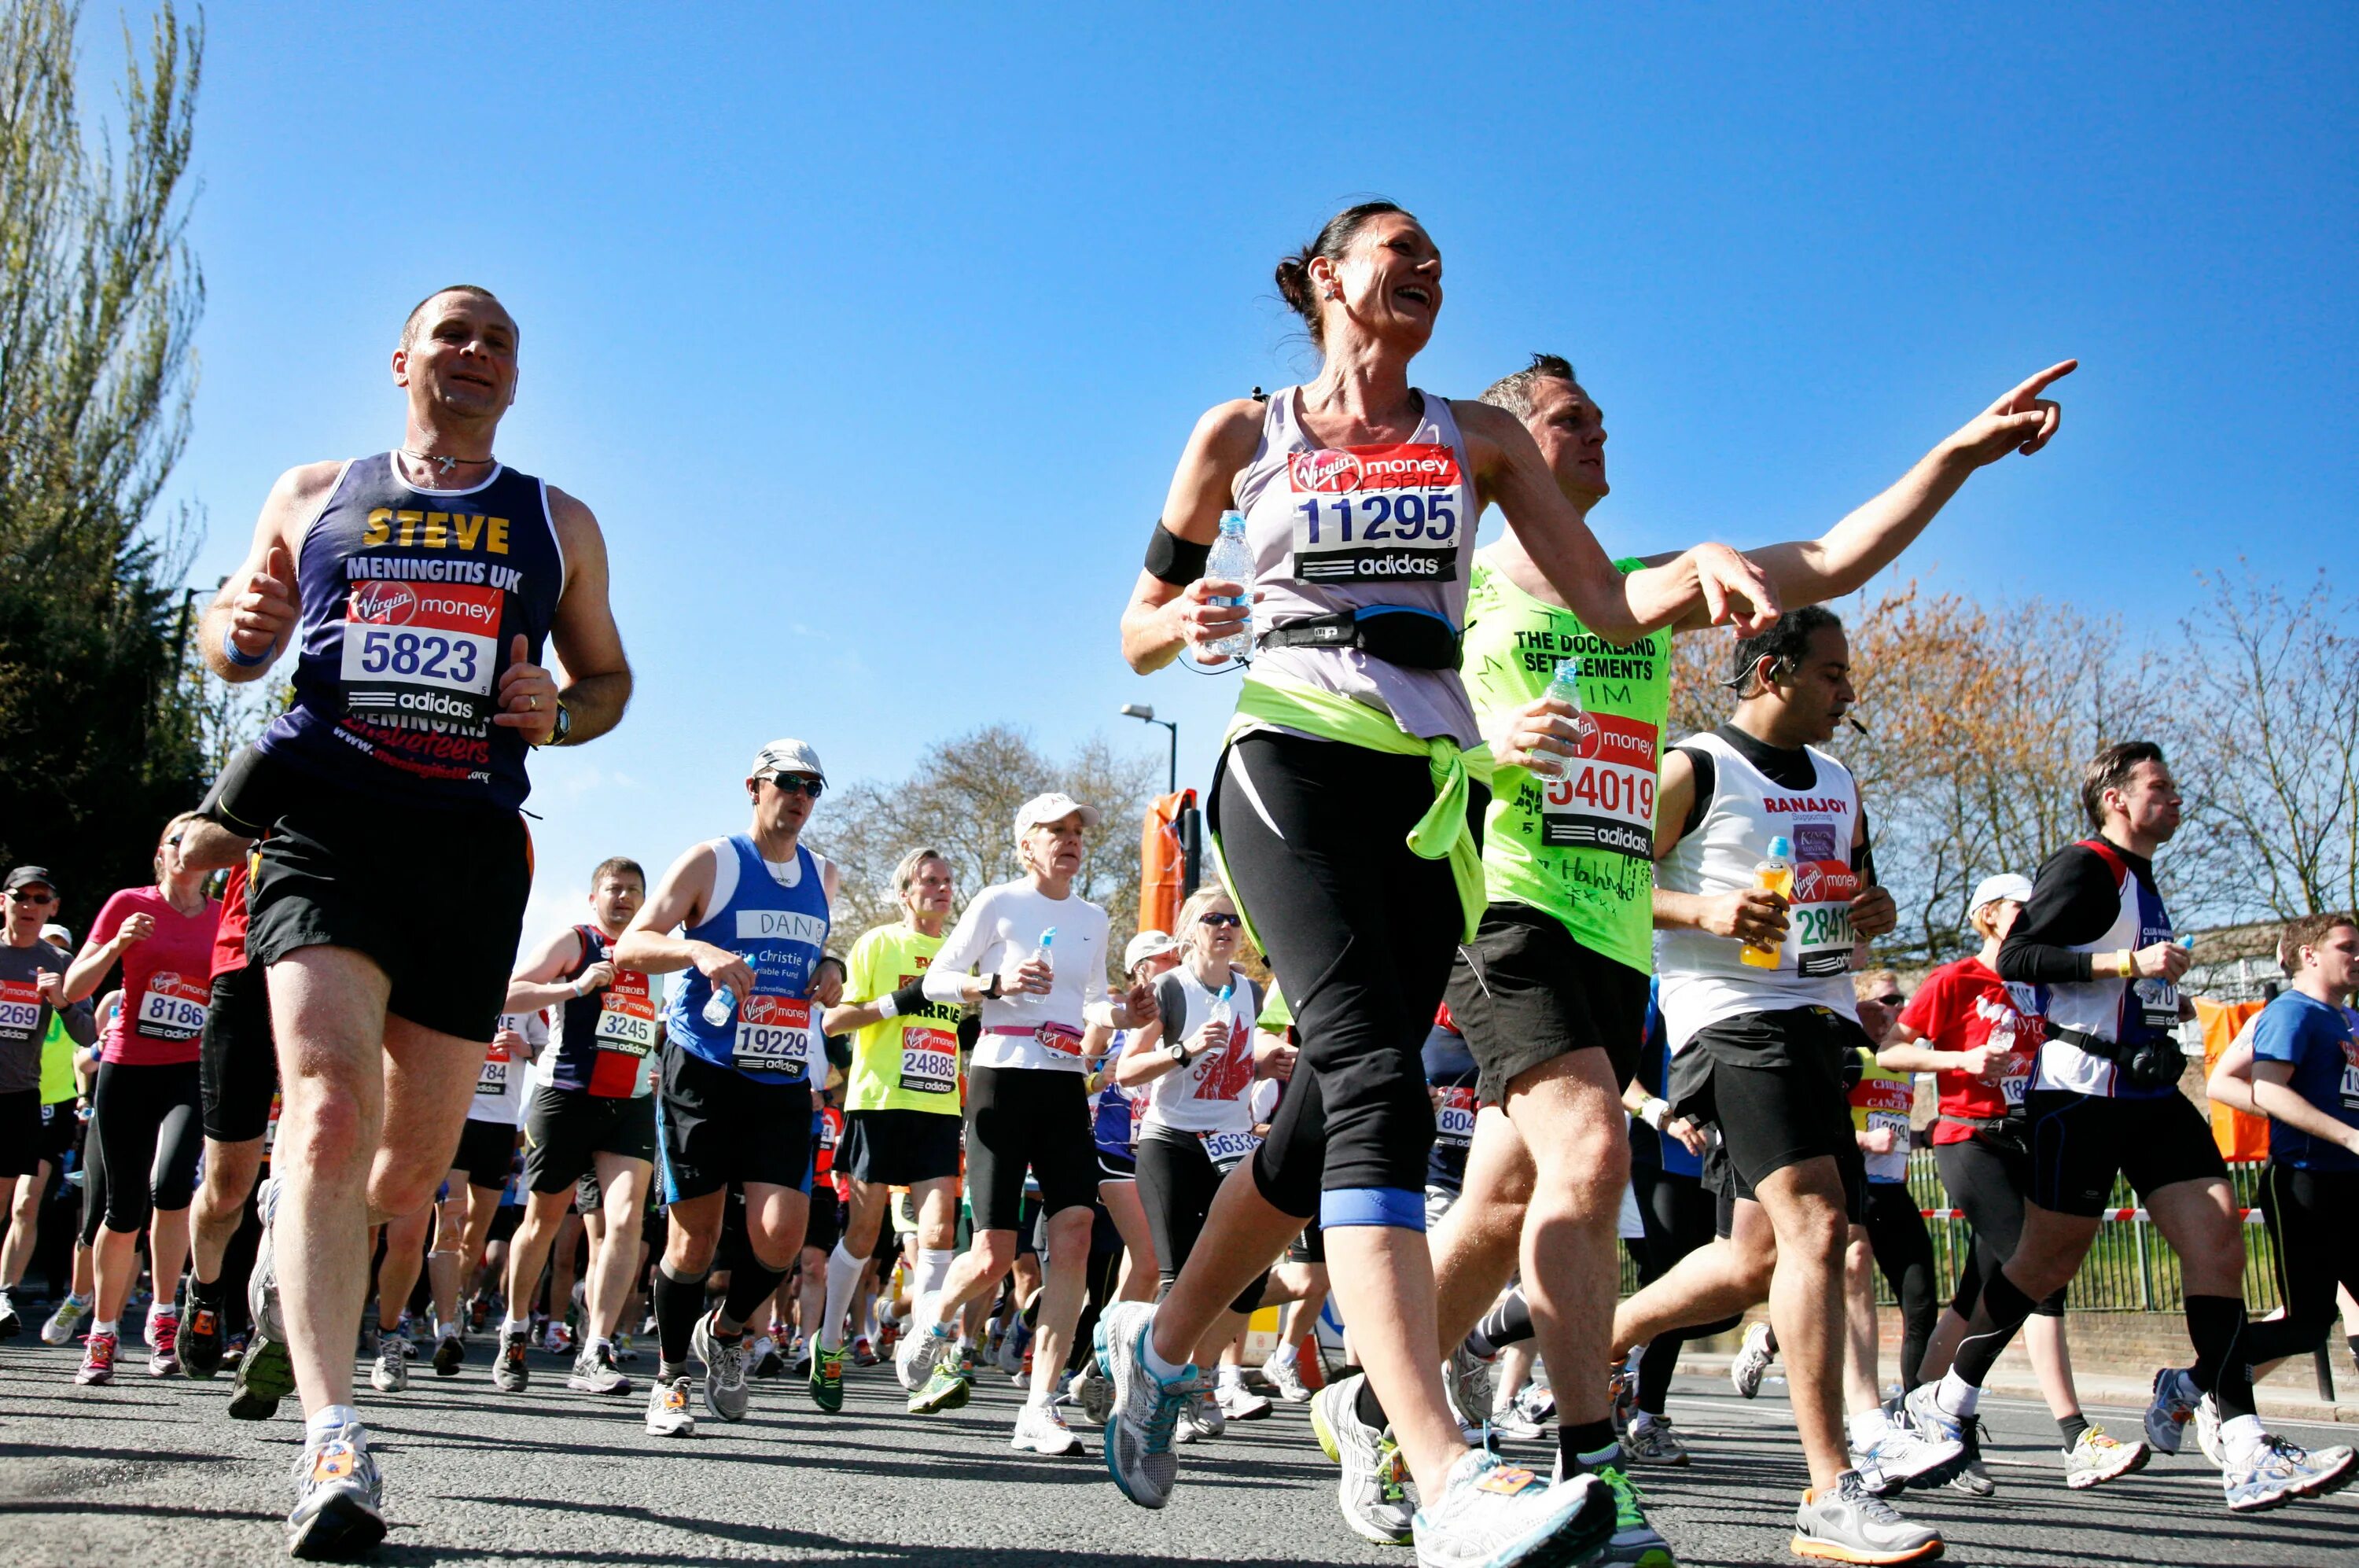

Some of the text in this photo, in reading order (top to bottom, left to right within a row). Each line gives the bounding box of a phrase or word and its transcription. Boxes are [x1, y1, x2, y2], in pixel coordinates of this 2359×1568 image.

[1299, 454, 1448, 489] Virgin money
[1324, 472, 1452, 495] DEBBIE
[362, 507, 510, 554] STEVE
[1298, 494, 1455, 544] 11295
[347, 557, 523, 594] MENINGITIS UK
[1359, 554, 1438, 575] adidas
[357, 583, 496, 624] Virgin money
[1514, 631, 1555, 650] THE
[362, 631, 477, 683] 5823
[1524, 652, 1652, 681] SETLEMENTS
[481, 686, 487, 695] 5
[399, 692, 473, 719] adidas
[1603, 731, 1654, 760] money
[1548, 766, 1654, 820] 54019
[1763, 797, 1848, 815] RANAJOY
[1791, 812, 1833, 822] Supporting
[1598, 826, 1647, 852] adidas
[1792, 864, 1821, 900] Virgin
[761, 914, 811, 937] DAN
[759, 949, 802, 966] Christie
[624, 973, 635, 982] for
[782, 970, 799, 980] Fund
[182, 983, 209, 997] mone
[615, 985, 646, 996] HEROES
[149, 997, 204, 1026] 8186
[628, 1001, 653, 1016] money
[745, 996, 808, 1023] Virgin money
[605, 1014, 648, 1040] 3245
[907, 1027, 956, 1051] Virgin money
[618, 1042, 646, 1057] adidas
[740, 1026, 808, 1057] 19229
[766, 1058, 799, 1073] adidas
[903, 1052, 955, 1077] 24885
[925, 1081, 951, 1092] adidas
[1867, 1098, 1908, 1110] CANCER
